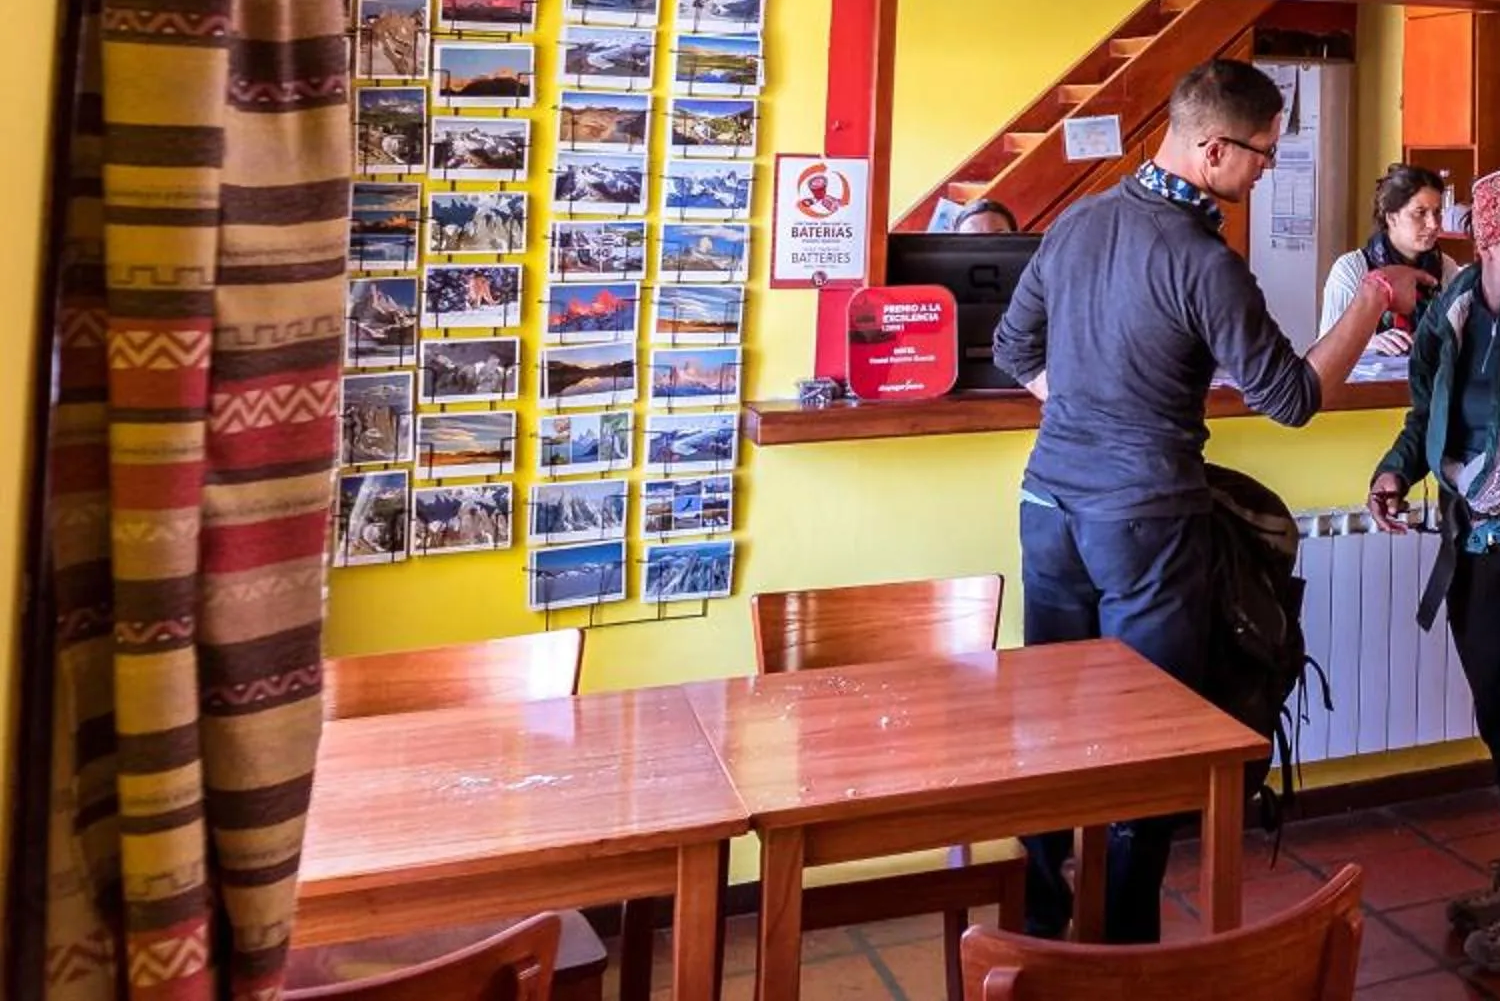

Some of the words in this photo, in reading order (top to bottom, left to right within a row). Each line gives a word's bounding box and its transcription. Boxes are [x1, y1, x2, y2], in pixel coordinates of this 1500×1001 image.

[791, 226, 853, 238] BATERIAS
[791, 252, 851, 264] BATTERIES
[928, 303, 942, 312] LA
